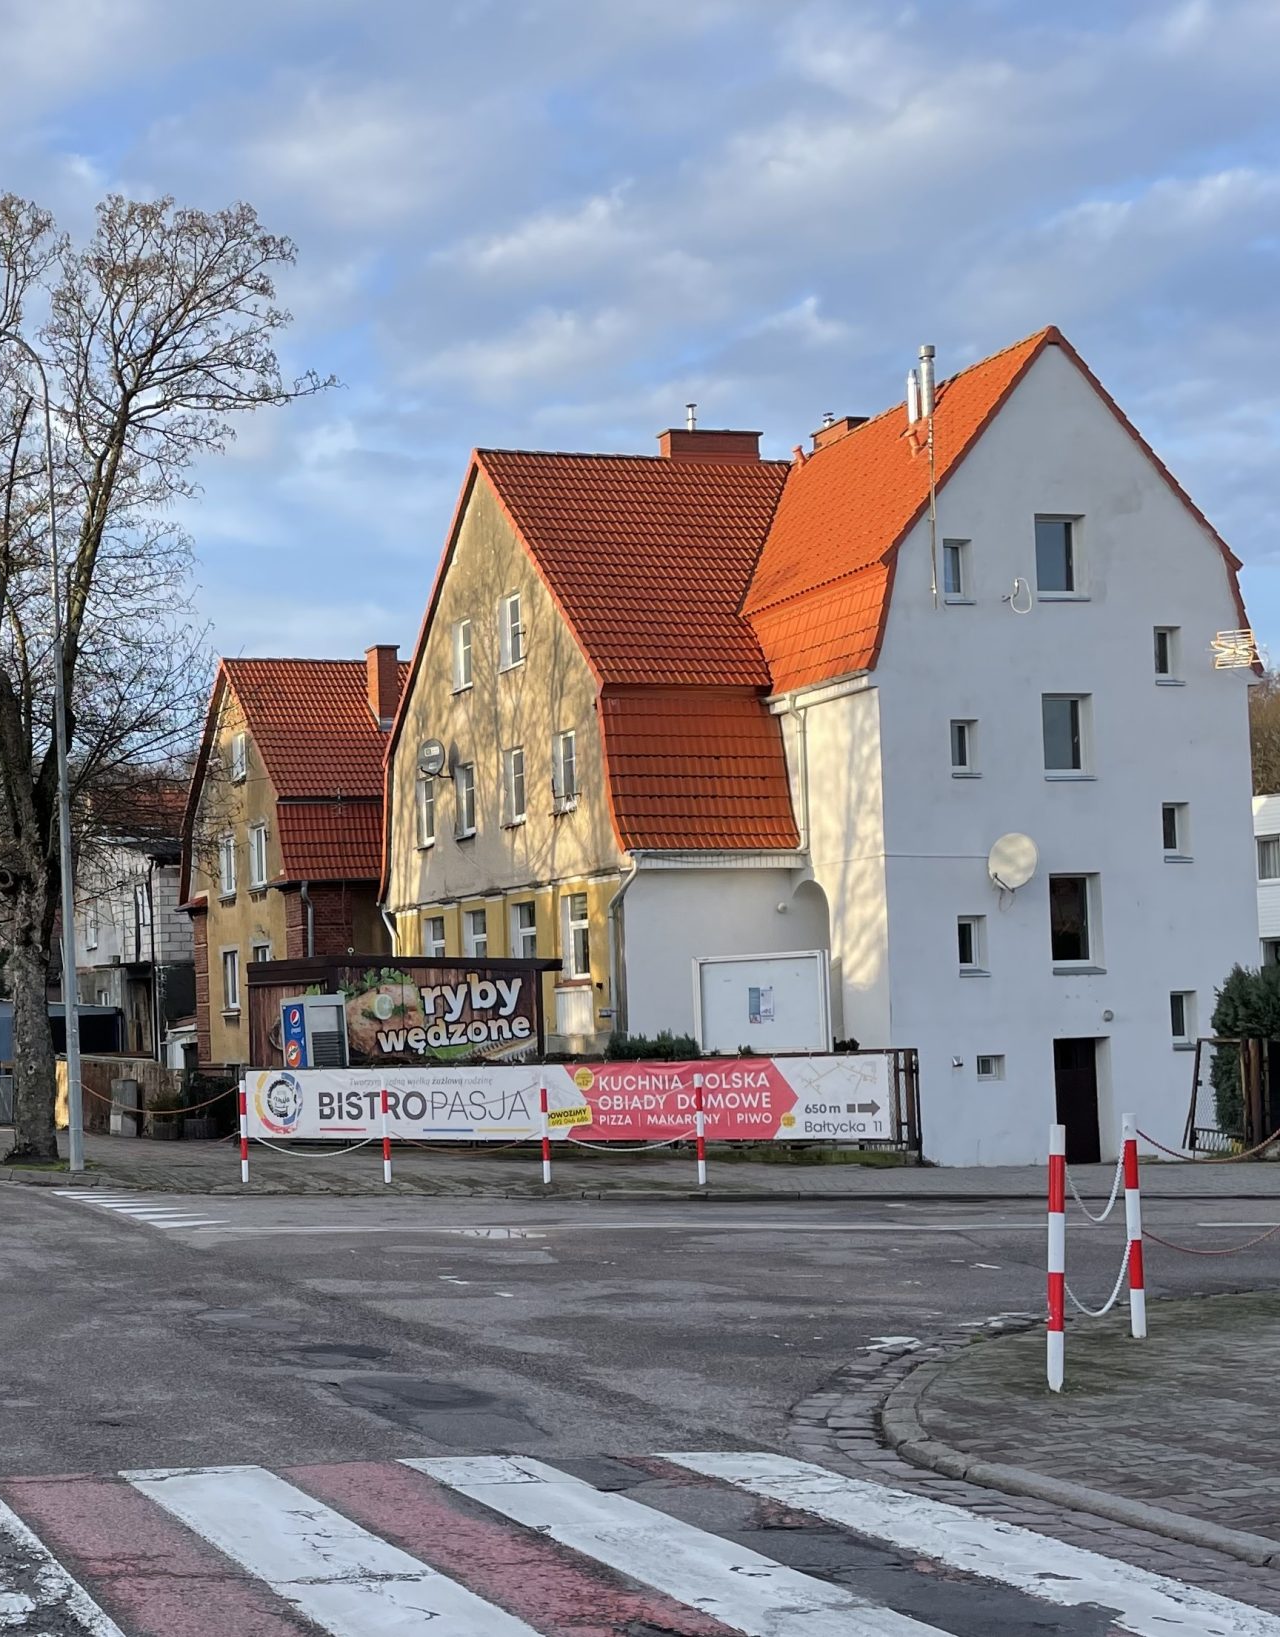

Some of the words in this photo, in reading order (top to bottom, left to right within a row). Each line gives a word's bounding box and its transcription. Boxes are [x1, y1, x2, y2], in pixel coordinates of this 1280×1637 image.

[421, 973, 522, 1021] ryby
[376, 1016, 531, 1055] wędzone
[350, 1078, 382, 1087] Tworzym
[599, 1074, 684, 1091] KUCHNIA
[700, 1072, 770, 1089] OLSKA
[598, 1094, 668, 1111] OBIADY
[677, 1092, 772, 1109] DOMOWE
[804, 1103, 827, 1114] 650
[599, 1114, 633, 1126] PIZZA
[736, 1112, 773, 1124] PIWO
[804, 1120, 866, 1135] Bałtycka
[874, 1120, 883, 1132] 11
